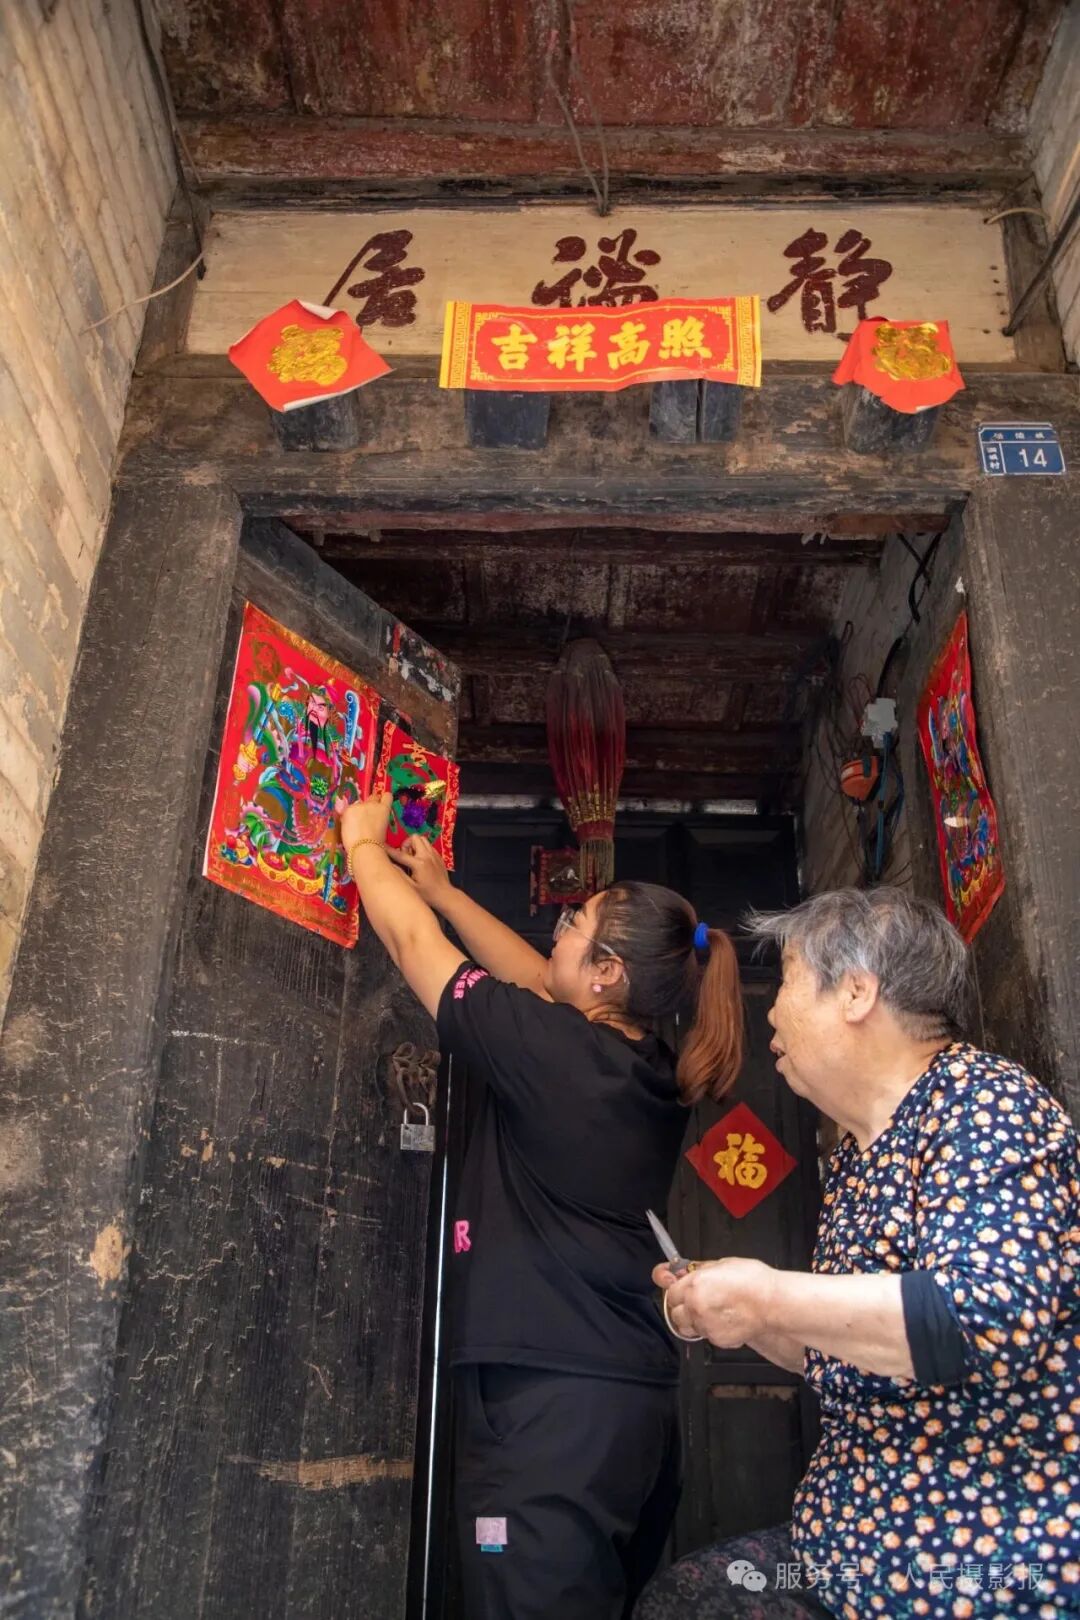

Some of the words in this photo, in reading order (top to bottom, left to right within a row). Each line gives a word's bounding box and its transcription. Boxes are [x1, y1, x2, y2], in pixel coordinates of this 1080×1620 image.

[491, 315, 712, 373] 吉祥高照
[1019, 448, 1048, 468] 14
[713, 1133, 768, 1189] 福
[454, 1220, 471, 1253] R
